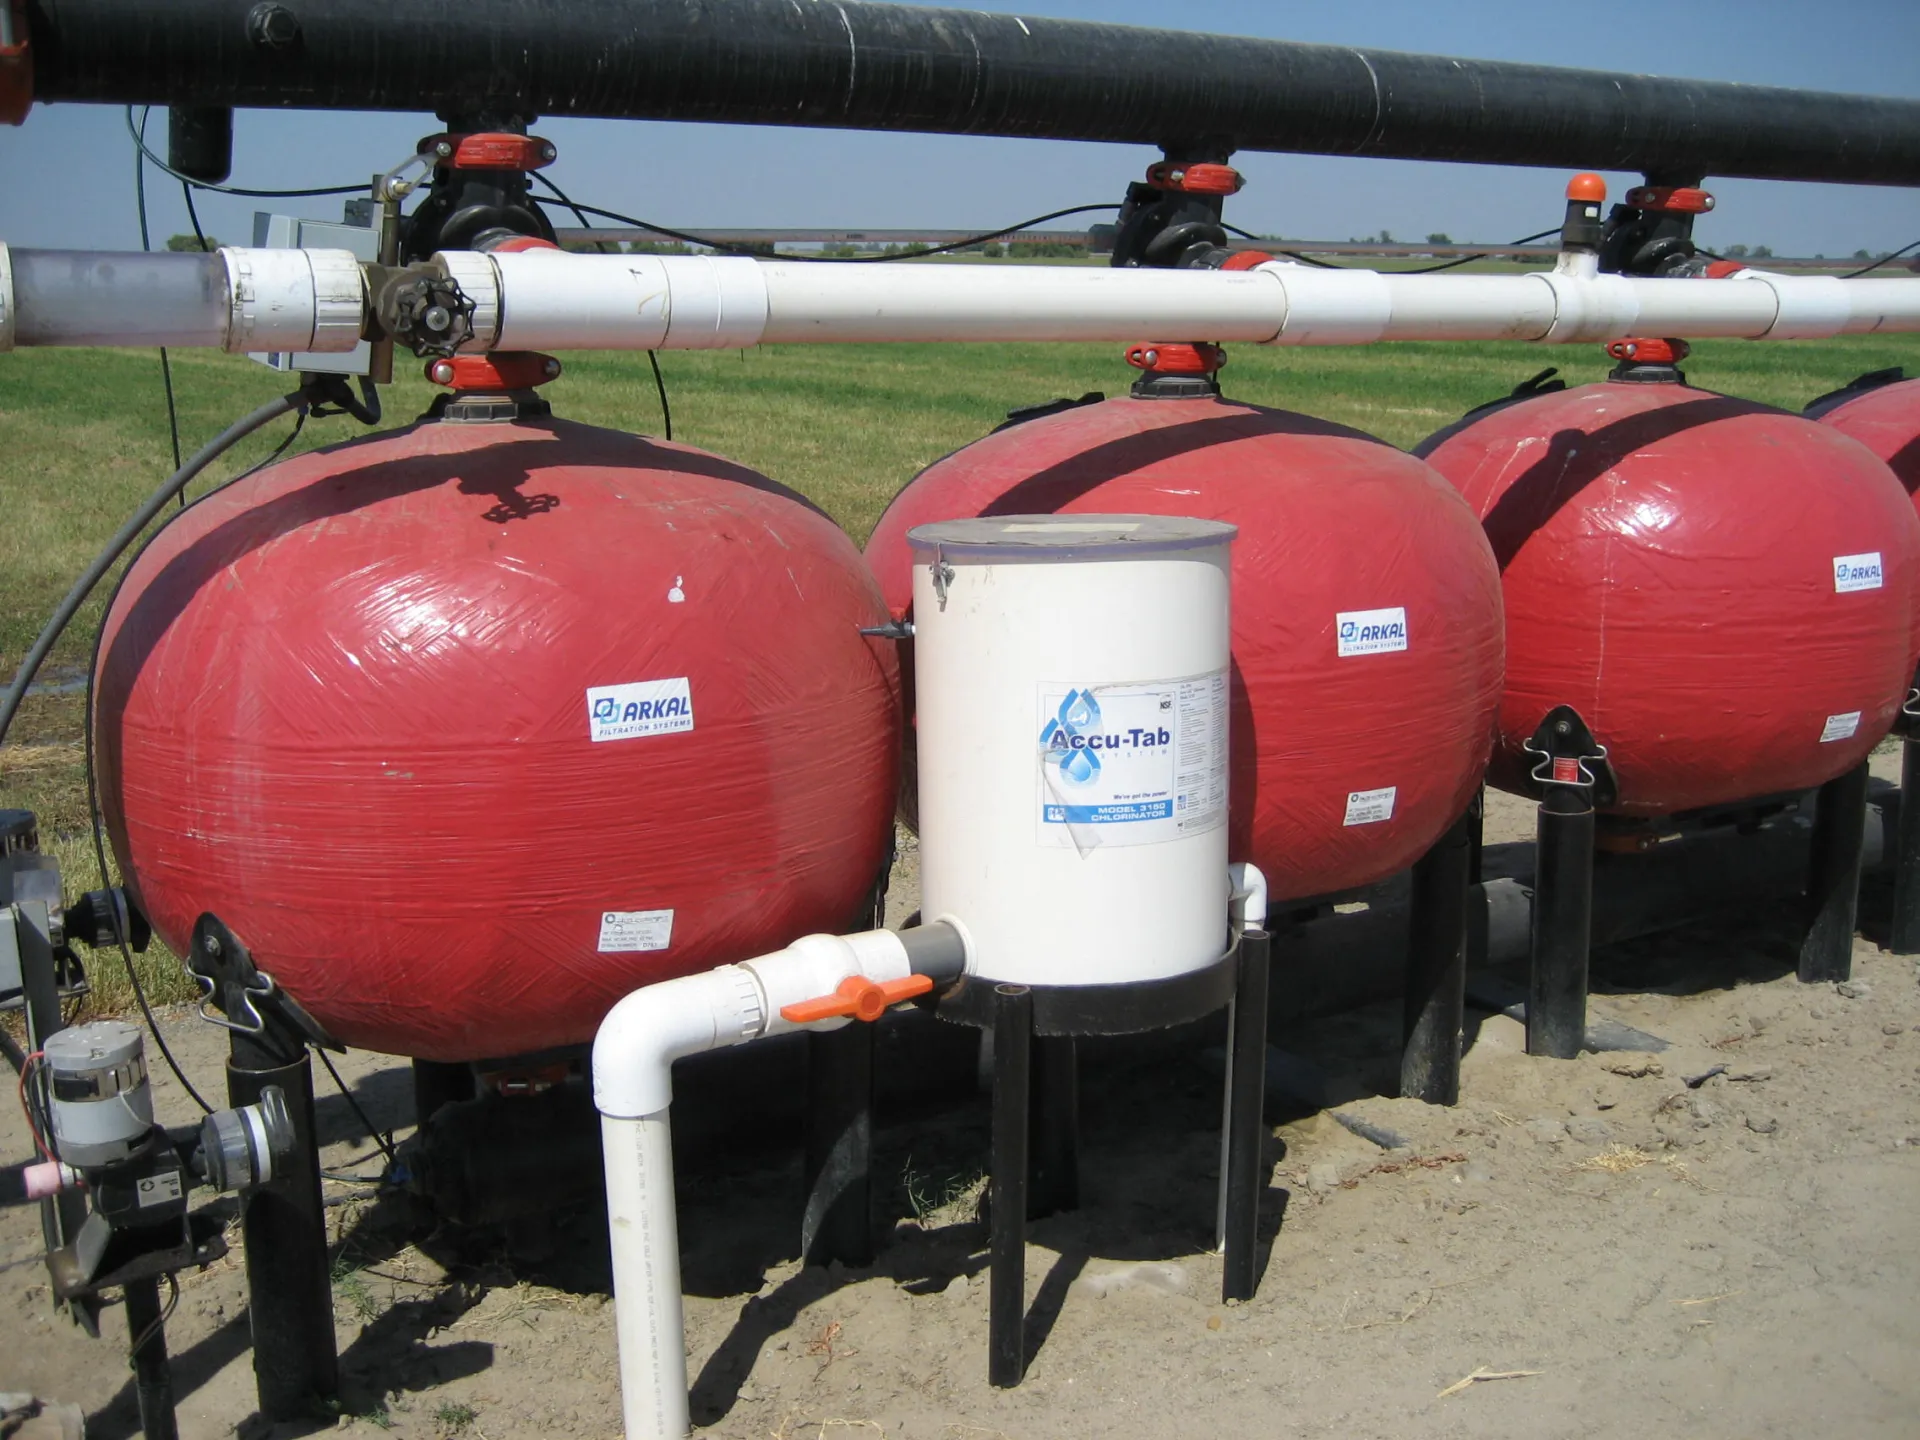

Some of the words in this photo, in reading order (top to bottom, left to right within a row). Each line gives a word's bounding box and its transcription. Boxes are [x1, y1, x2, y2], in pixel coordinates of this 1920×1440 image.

[1851, 565, 1881, 580] ARKAL
[1360, 622, 1405, 642] ARKAL
[622, 696, 690, 722] ARKAL
[1160, 700, 1172, 710] NSF
[600, 724, 649, 736] FILTRATION
[653, 719, 691, 730] SYSTEMS
[1050, 726, 1170, 750] Accu-Tab
[1091, 810, 1165, 822] CHLORINATOR
[1098, 805, 1136, 814] MODEL
